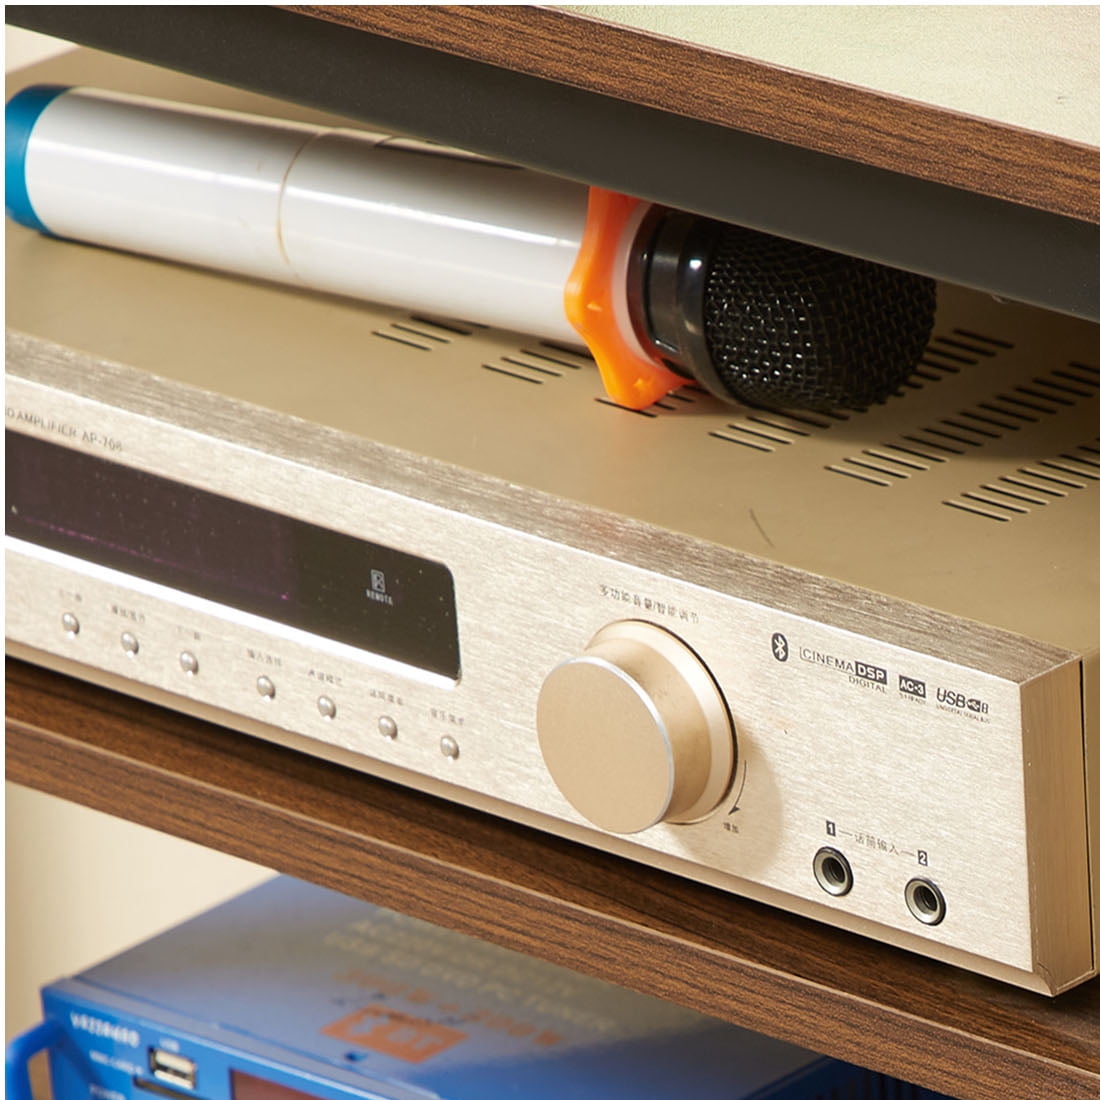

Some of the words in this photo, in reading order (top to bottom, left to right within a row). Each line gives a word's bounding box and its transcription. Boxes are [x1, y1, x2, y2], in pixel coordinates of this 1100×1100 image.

[16, 411, 77, 437] AMPLIFIER
[802, 648, 855, 673] CINEMA
[856, 663, 885, 682] DSP
[849, 675, 888, 694] DIGITAL
[936, 687, 966, 708] USB
[827, 821, 836, 836] 1
[918, 850, 928, 866] 2
